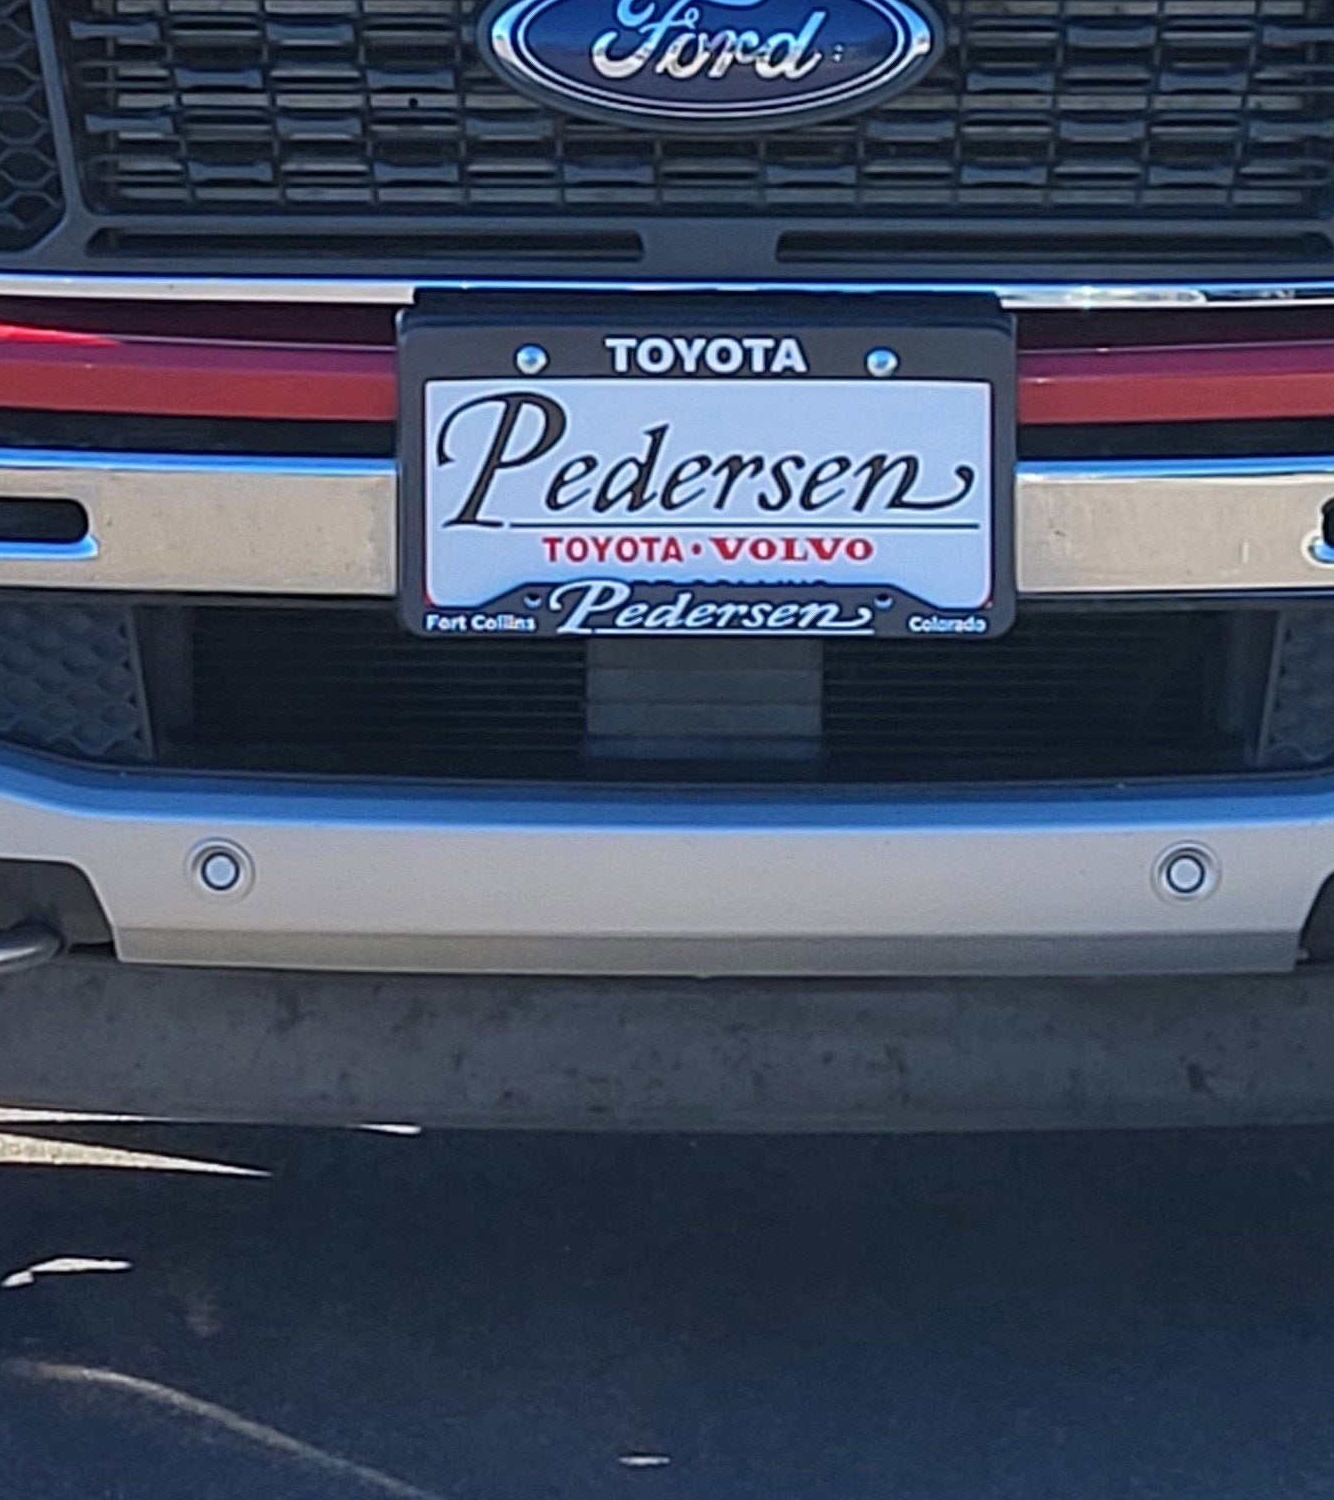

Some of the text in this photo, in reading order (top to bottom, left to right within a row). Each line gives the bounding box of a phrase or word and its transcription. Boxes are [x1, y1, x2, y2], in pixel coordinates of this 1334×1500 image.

[604, 337, 808, 374] TOYOTA
[436, 390, 977, 529] Pedersen
[542, 536, 876, 563] TOYOTA VOLVO
[425, 613, 536, 631] Fort Collins
[549, 580, 874, 634] Pedersen
[907, 614, 988, 632] Colorado
